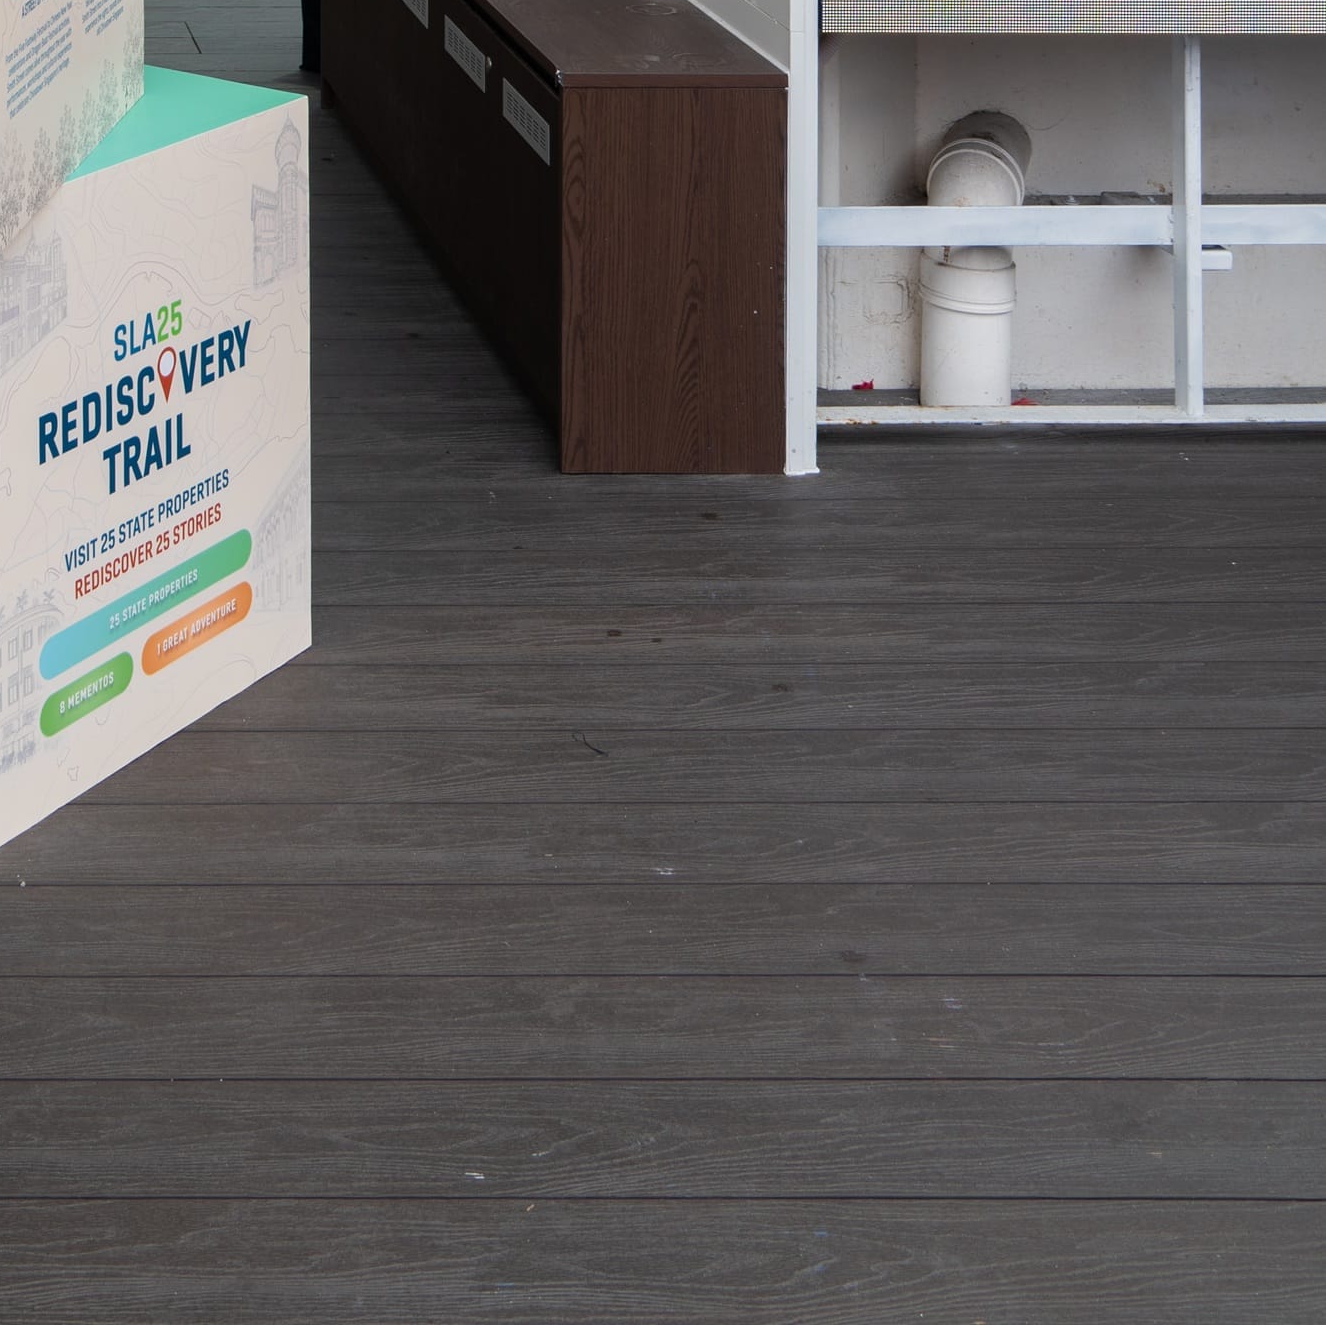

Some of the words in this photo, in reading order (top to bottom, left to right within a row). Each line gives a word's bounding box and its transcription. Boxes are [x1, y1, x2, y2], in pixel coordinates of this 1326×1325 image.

[113, 299, 183, 361] SLA25
[103, 413, 191, 495] TRAIL
[65, 538, 97, 572] VISIT
[101, 528, 115, 554] 25
[119, 508, 154, 544] STATE
[159, 469, 228, 523] PROPERTIES
[76, 540, 152, 599] REDISCOVER
[157, 530, 169, 555] 25
[174, 503, 221, 545] STORIES
[110, 612, 120, 629] 25
[123, 597, 146, 622] STATE
[149, 569, 197, 606] PROPERTIES
[158, 643, 160, 654] 1
[163, 625, 187, 651] GREAT
[190, 598, 235, 636] ADVENTURE
[60, 701, 65, 714] 8
[68, 671, 113, 709] MEMENTOS
